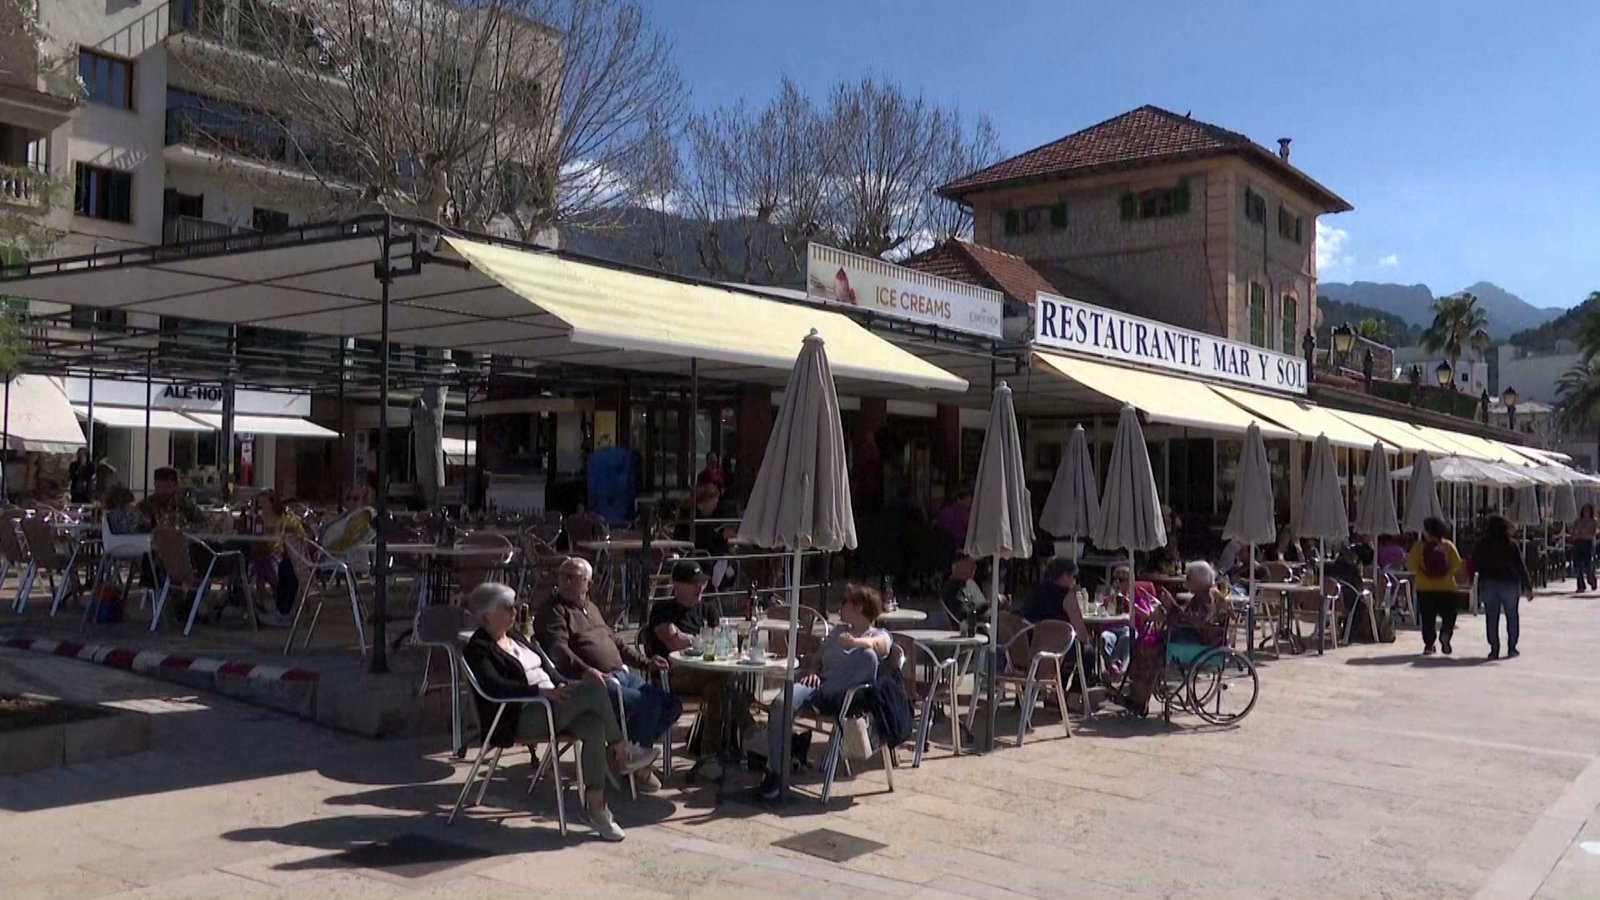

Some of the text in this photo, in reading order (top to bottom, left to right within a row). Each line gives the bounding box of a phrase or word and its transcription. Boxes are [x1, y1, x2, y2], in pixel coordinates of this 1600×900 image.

[876, 286, 897, 307] ICE
[900, 292, 951, 320] CREAMS
[1040, 300, 1305, 389] RESTAURANTE MAR Y SOL
